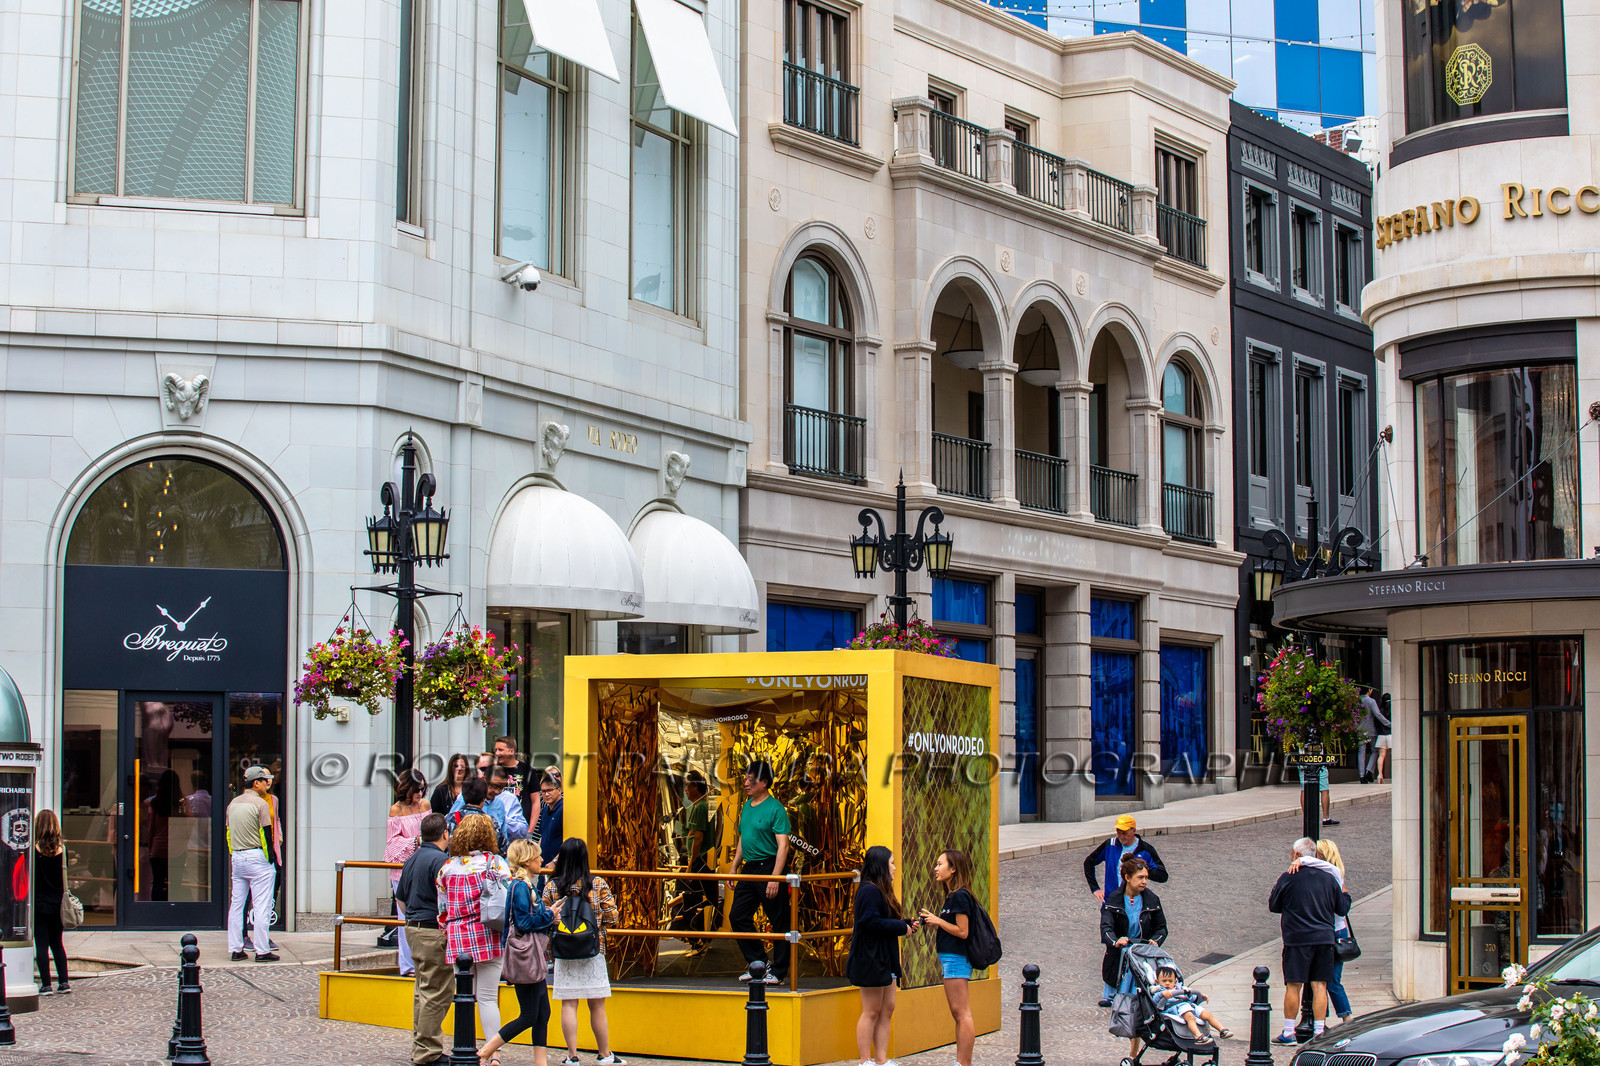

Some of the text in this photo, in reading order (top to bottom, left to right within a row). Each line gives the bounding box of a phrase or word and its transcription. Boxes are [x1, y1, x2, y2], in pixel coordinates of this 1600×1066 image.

[1376, 196, 1480, 249] STEFANO
[587, 424, 638, 455] VIA RODEO
[1368, 580, 1446, 596] STEFANO RICCI
[123, 623, 228, 662] Breguet
[183, 654, 206, 662] Depuis
[1448, 669, 1527, 684] STEFANO RICCI
[908, 731, 985, 757] #ONLYONRODEO
[1299, 755, 1323, 763] RODEO
[1325, 755, 1336, 763] DR
[1484, 943, 1497, 952] 270
